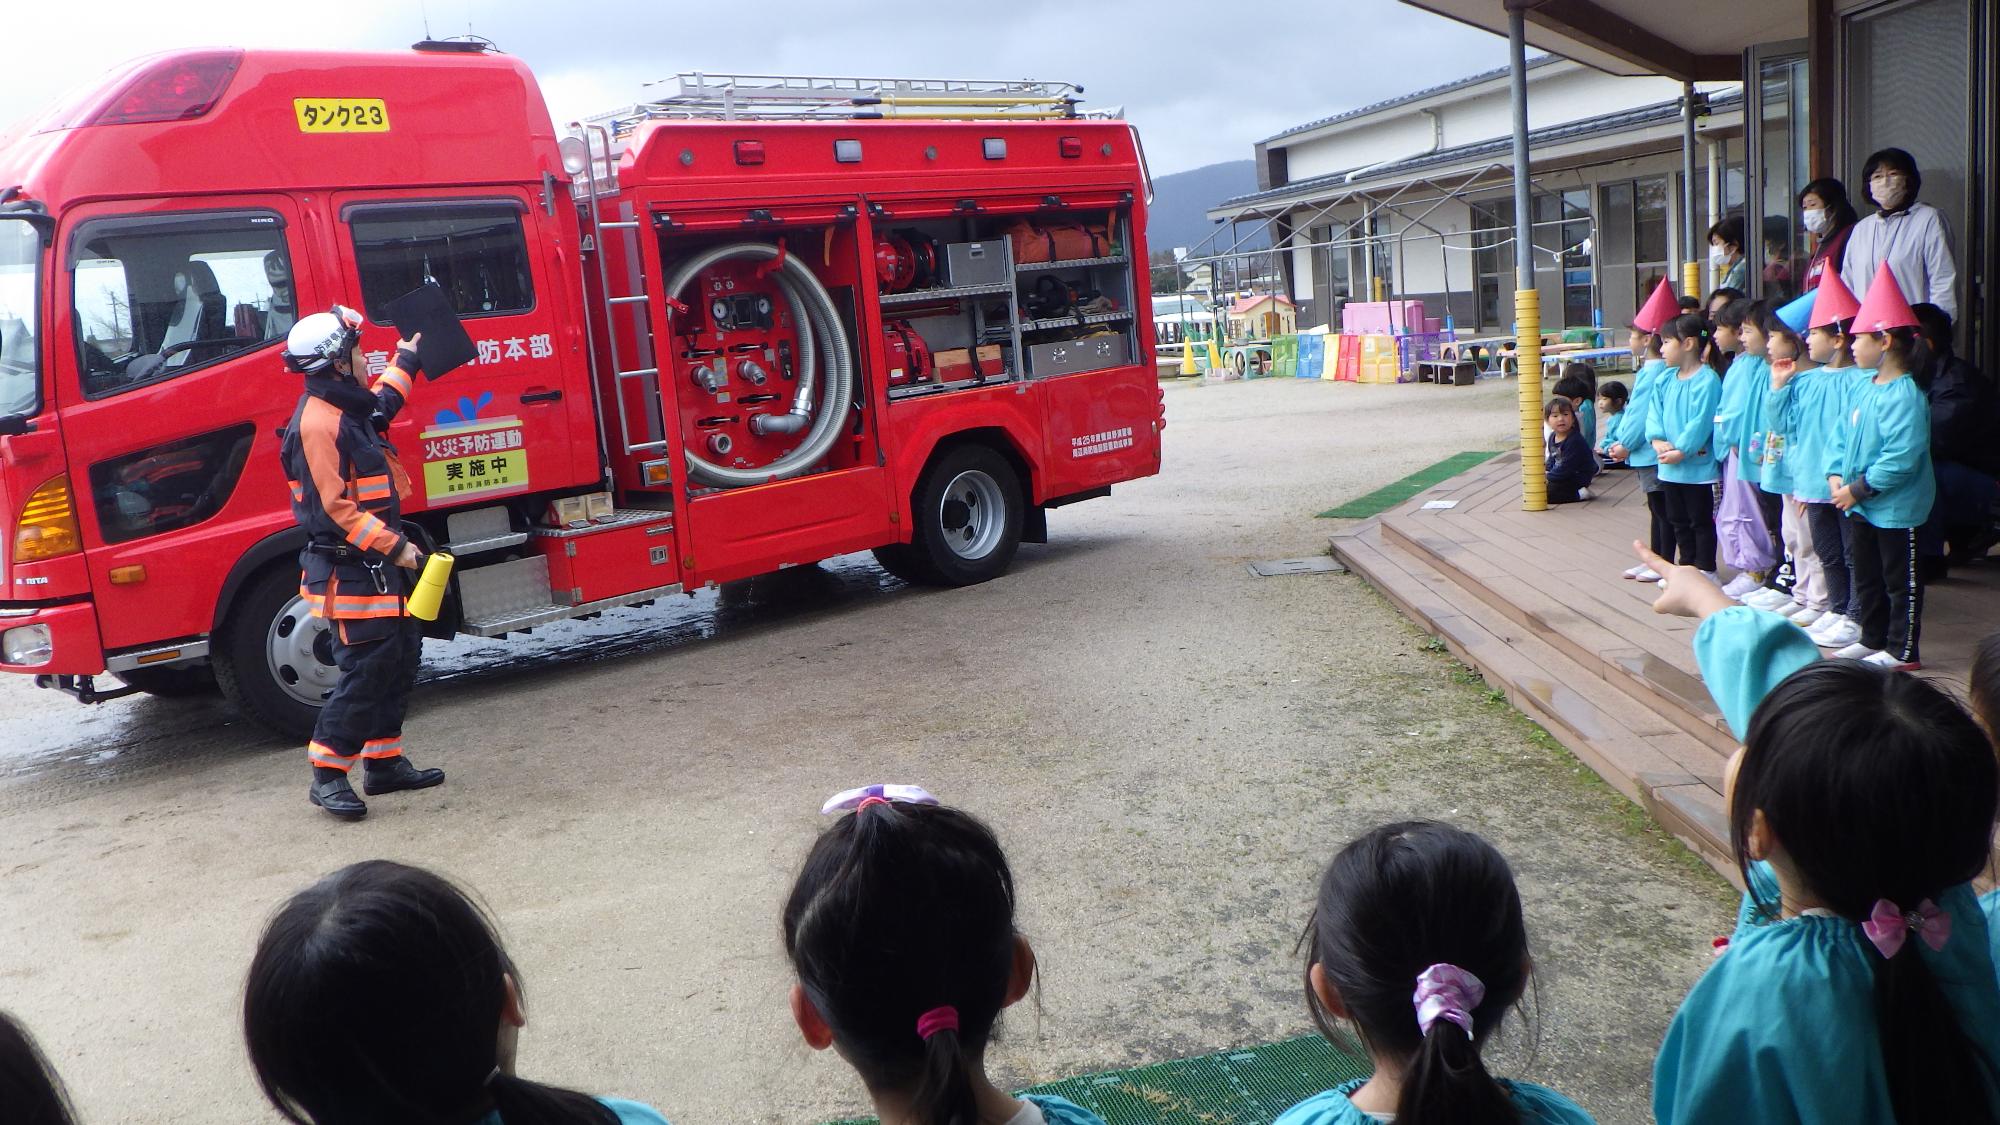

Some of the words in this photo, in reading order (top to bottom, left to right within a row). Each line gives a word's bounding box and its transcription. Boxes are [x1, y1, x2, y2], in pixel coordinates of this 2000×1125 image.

[304, 105, 383, 126] タンク23
[425, 429, 522, 459] 火災予防運動
[446, 456, 507, 481] 実施中
